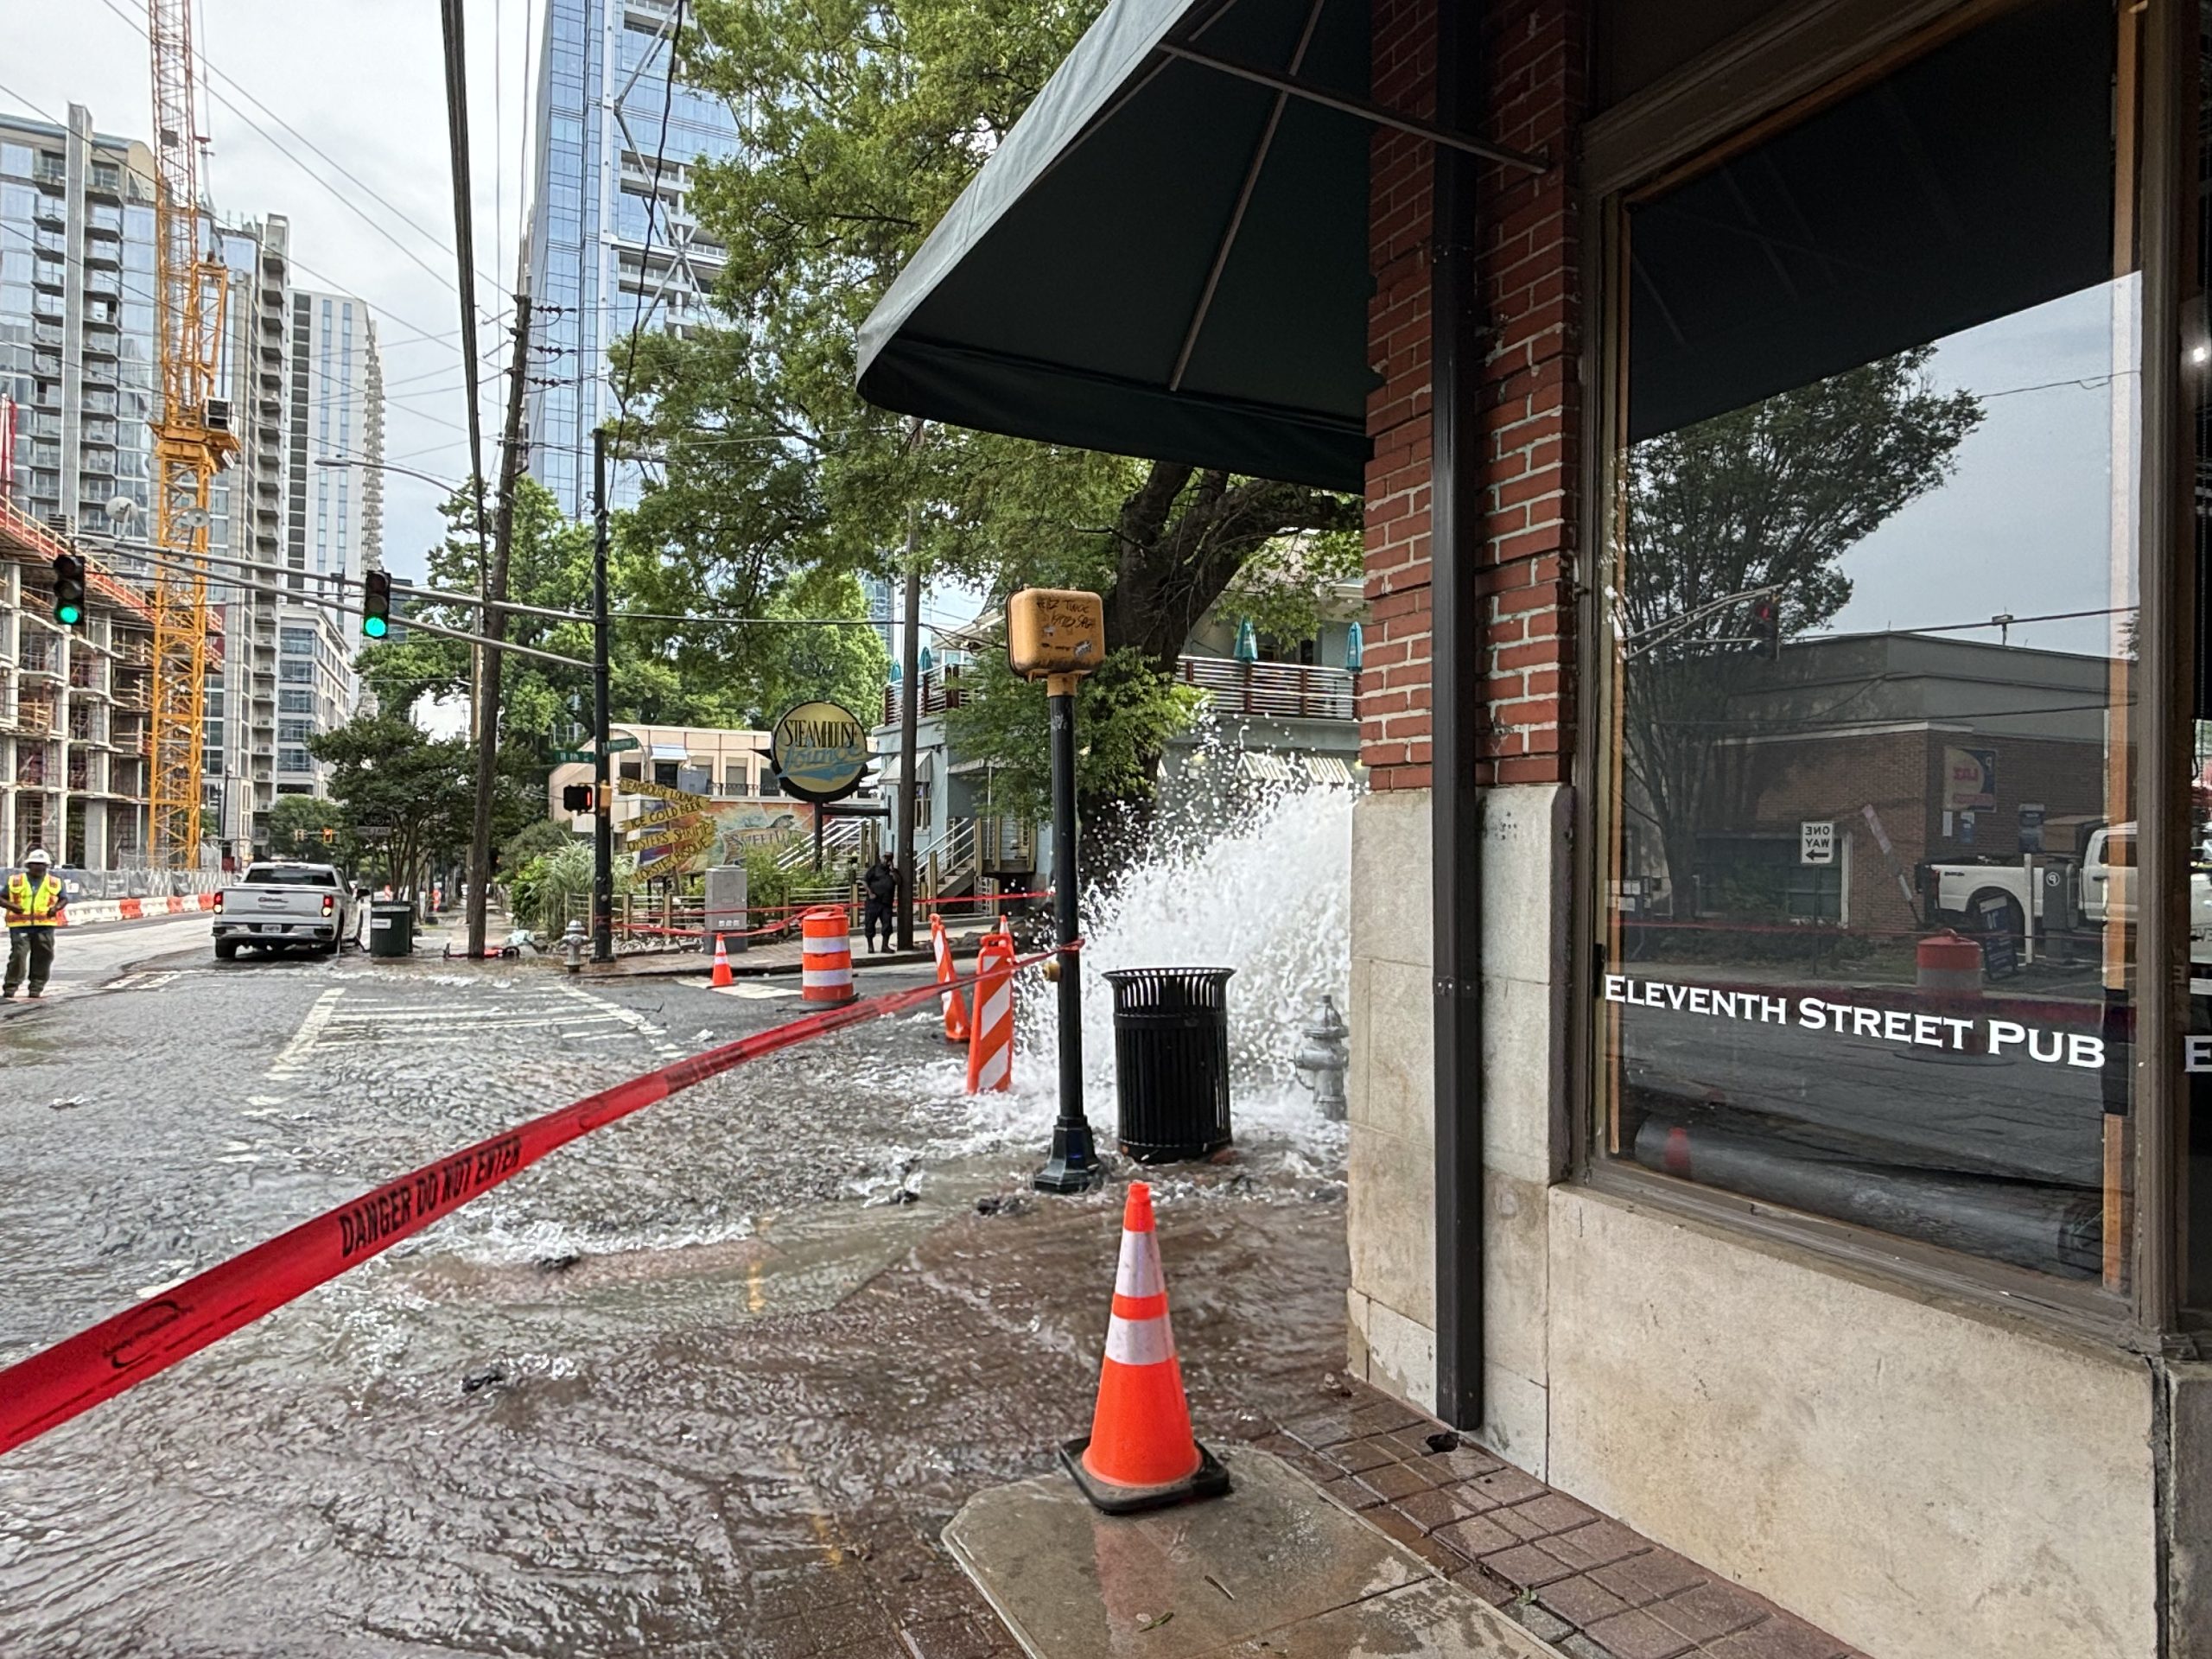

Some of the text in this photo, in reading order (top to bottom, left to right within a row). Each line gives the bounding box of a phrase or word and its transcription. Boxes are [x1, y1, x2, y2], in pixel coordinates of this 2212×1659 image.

[631, 801, 702, 830] ICE COLD BEER
[673, 823, 709, 841] SHRIMP
[1605, 974, 2106, 1069] ELEVENTH STREET PUB
[340, 1134, 522, 1258] DANGER DO NOT ENTER
